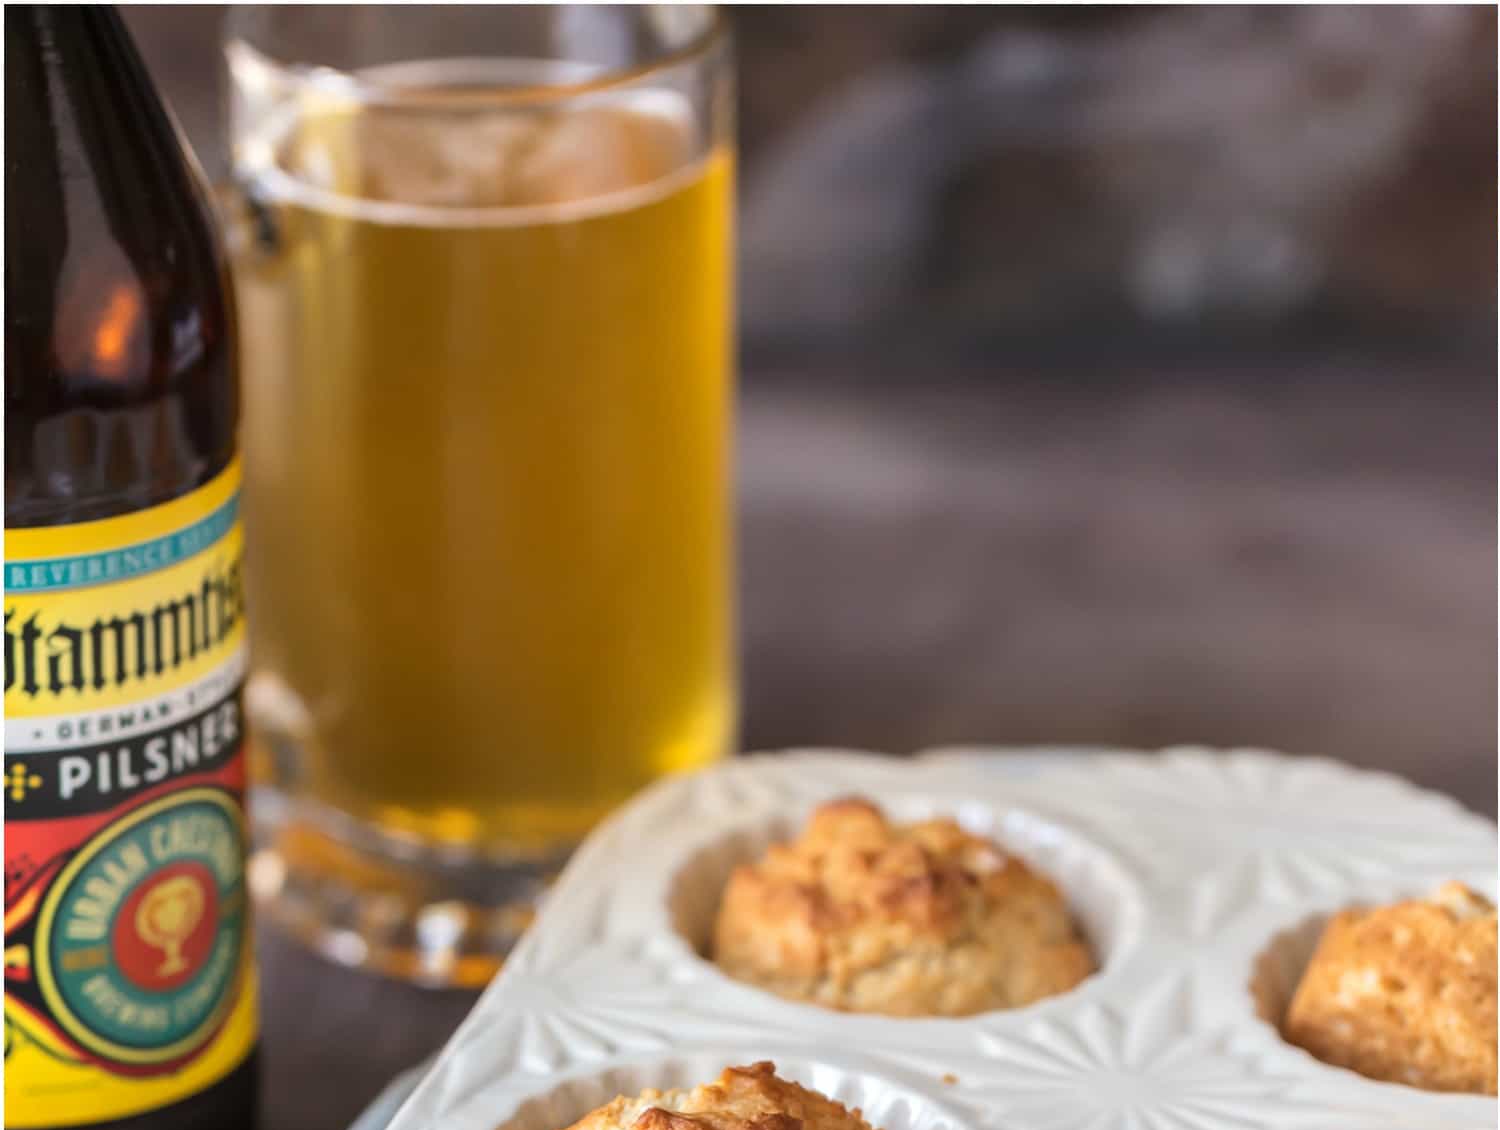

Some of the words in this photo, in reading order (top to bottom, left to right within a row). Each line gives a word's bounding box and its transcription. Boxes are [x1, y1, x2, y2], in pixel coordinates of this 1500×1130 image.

[11, 535, 175, 587] REVERENCE
[58, 701, 238, 799] PILSNER
[67, 842, 147, 939] URBAN
